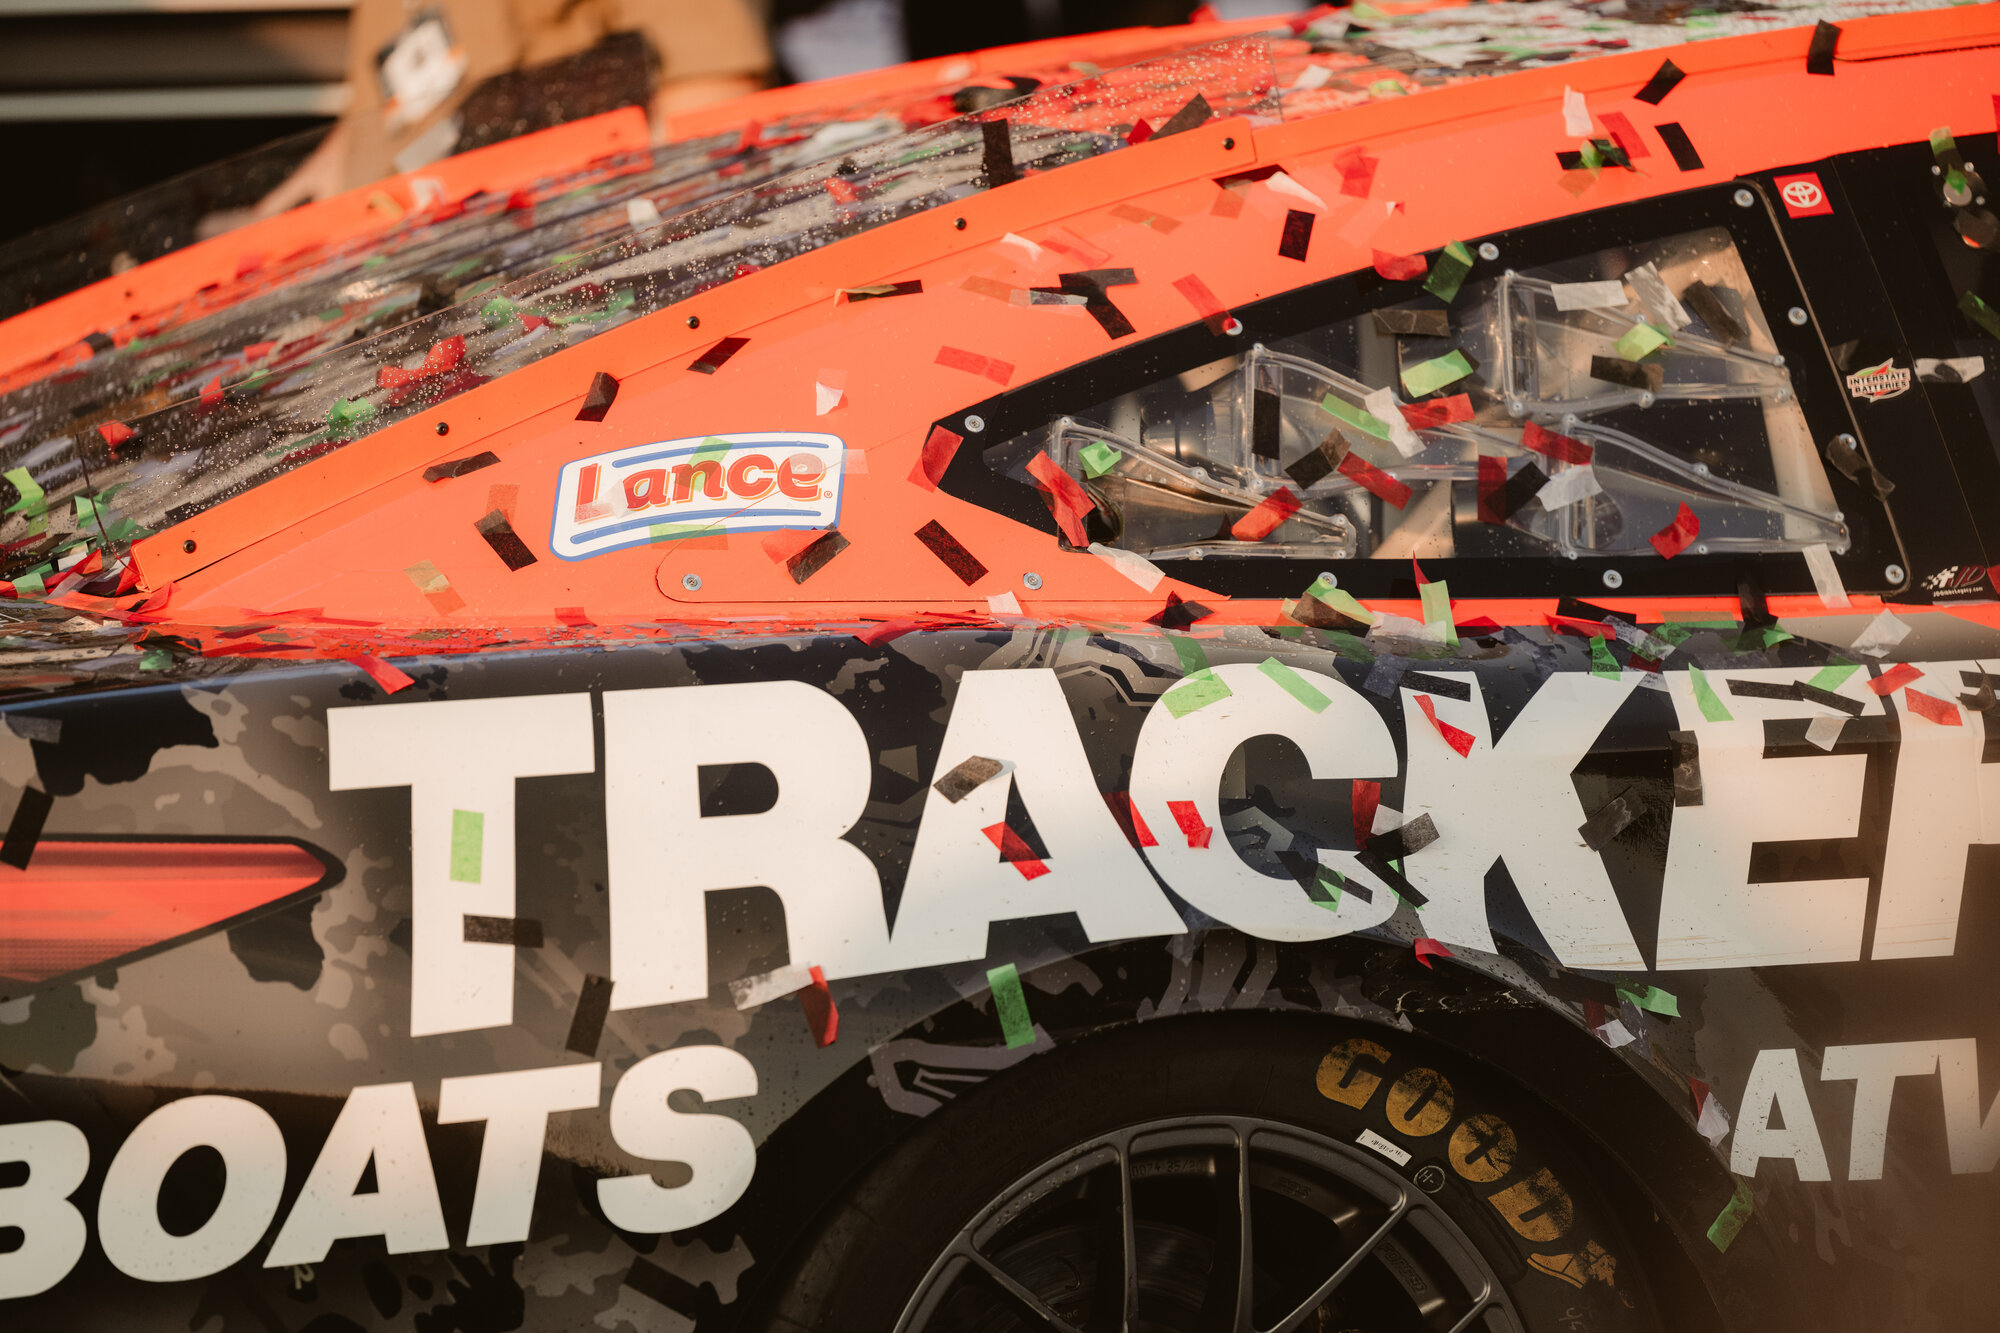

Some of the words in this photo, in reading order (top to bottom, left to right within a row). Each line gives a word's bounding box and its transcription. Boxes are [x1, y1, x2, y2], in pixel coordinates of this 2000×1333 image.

[1850, 372, 1907, 386] INTERSTATE
[1855, 381, 1906, 394] BATTERIES
[573, 451, 827, 526] Lance
